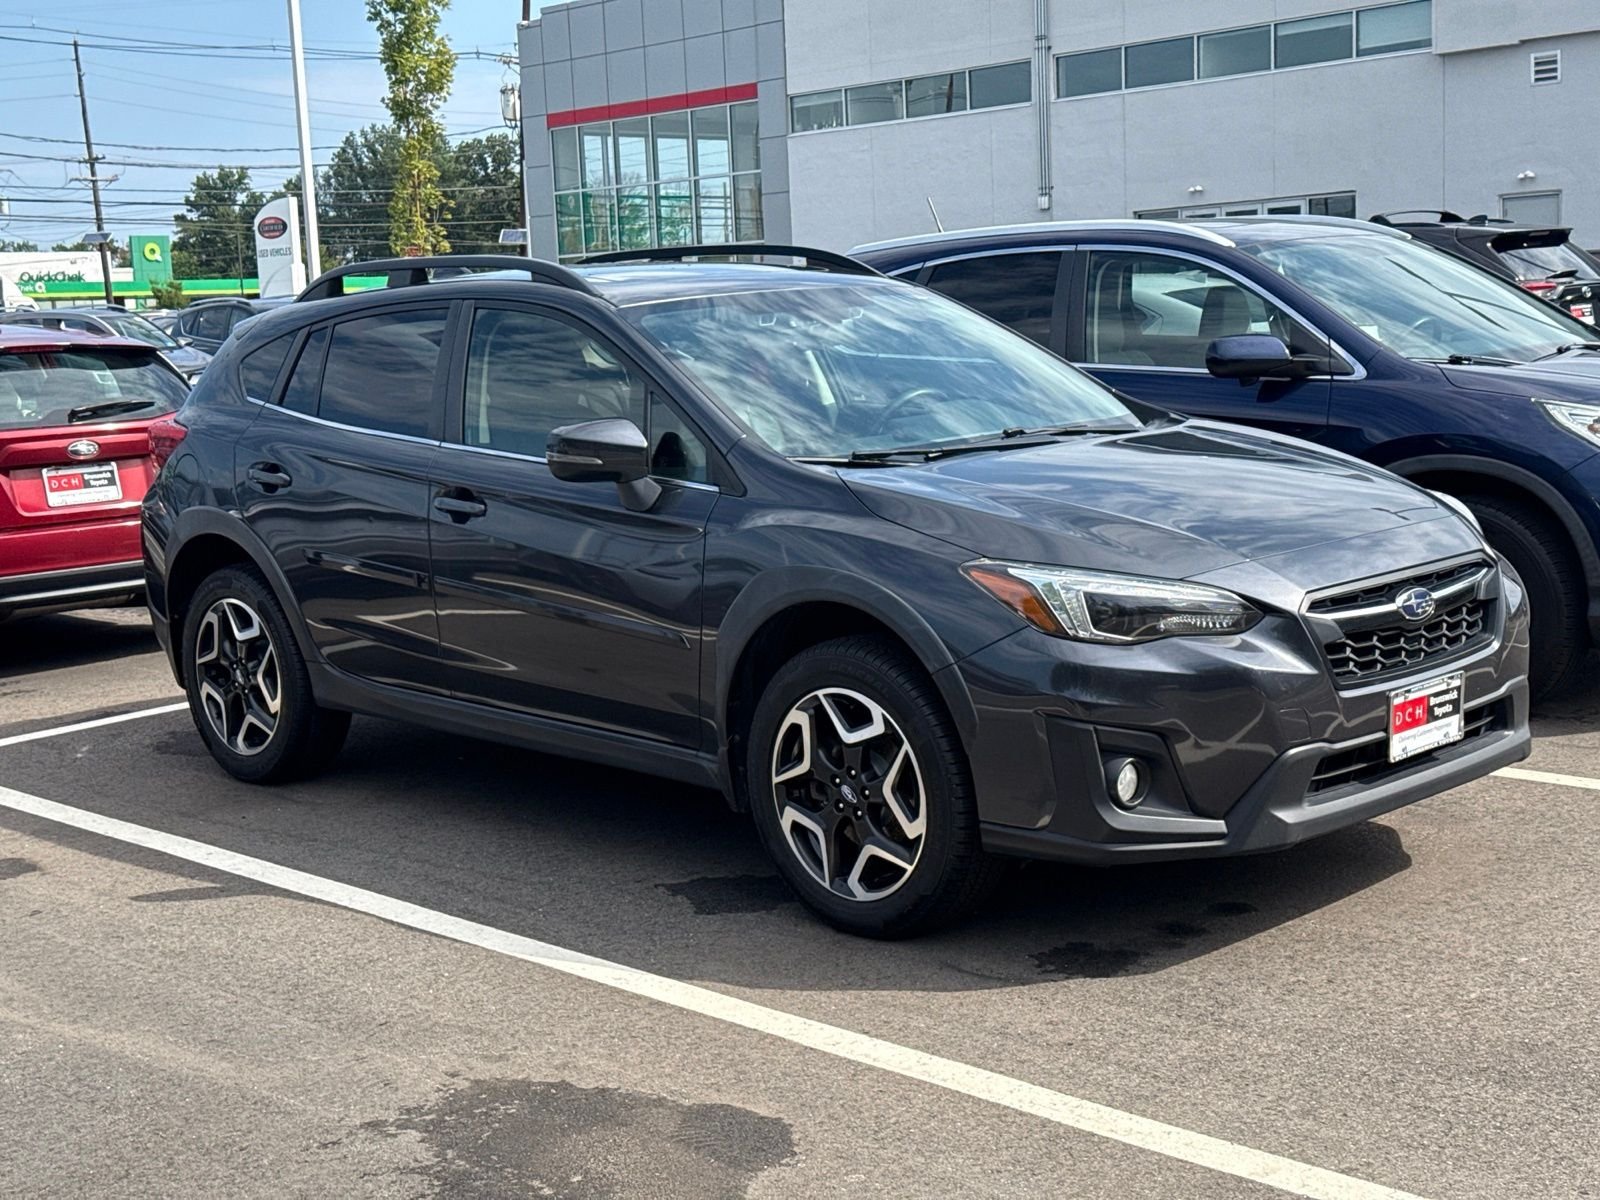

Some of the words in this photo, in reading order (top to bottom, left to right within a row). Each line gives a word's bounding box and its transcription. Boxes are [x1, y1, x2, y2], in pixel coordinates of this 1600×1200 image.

[144, 242, 162, 262] Q
[258, 249, 269, 258] USED
[270, 247, 292, 257] VEHICLES
[20, 270, 86, 282] QuickChek
[83, 471, 112, 480] Brunswick
[51, 477, 80, 489] DCH
[89, 479, 109, 487] Toyota
[1429, 689, 1458, 706] Brunswick
[1395, 704, 1423, 726] DCH
[1434, 703, 1453, 717] Toyota
